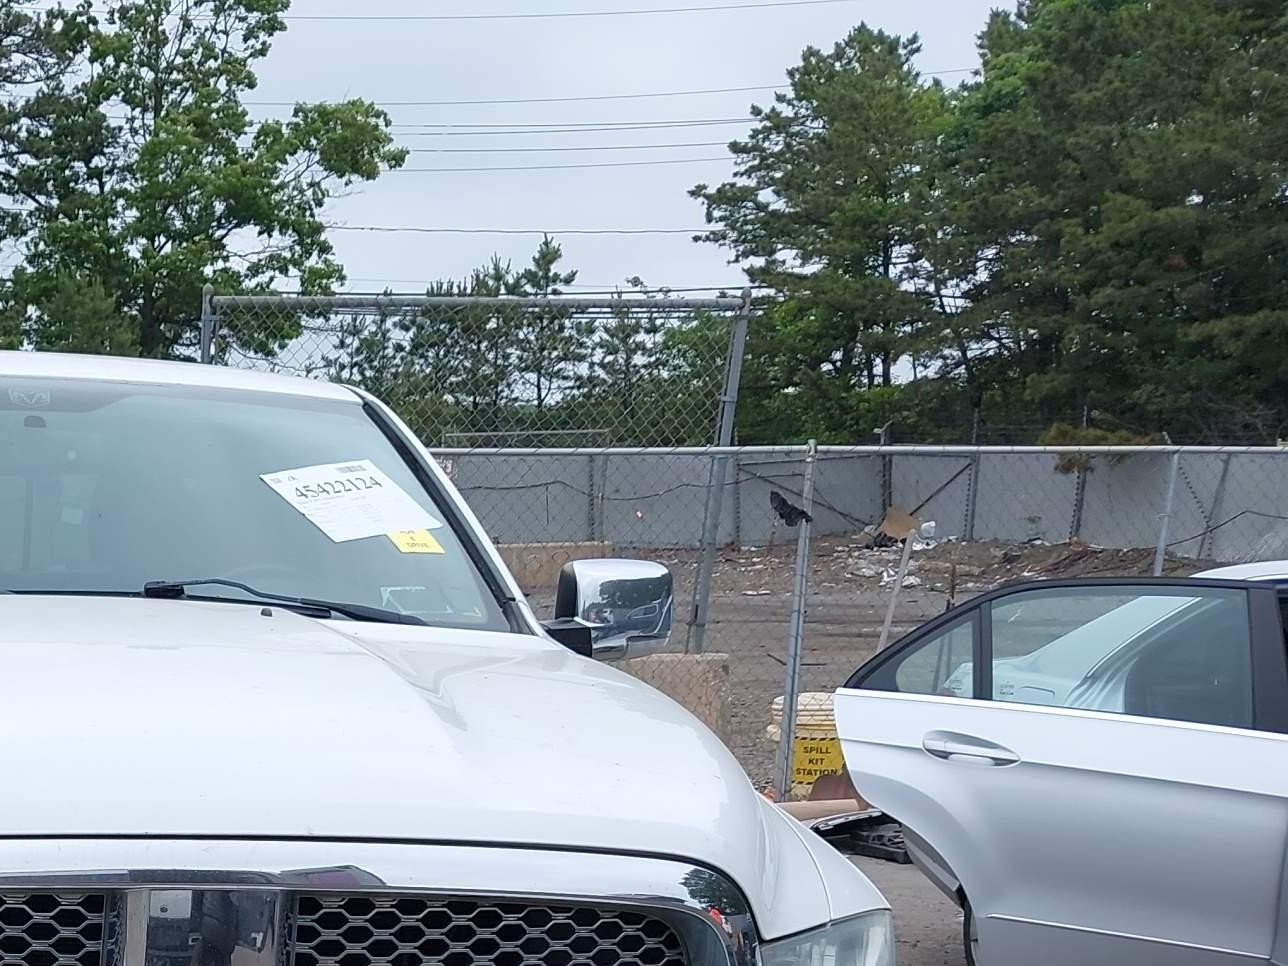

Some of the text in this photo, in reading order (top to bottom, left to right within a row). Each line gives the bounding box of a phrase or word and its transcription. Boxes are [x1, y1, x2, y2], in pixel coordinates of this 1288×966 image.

[295, 476, 383, 499] 45422124
[803, 746, 831, 754] SPILL
[808, 757, 825, 765] KIT
[795, 768, 838, 776] STATION
